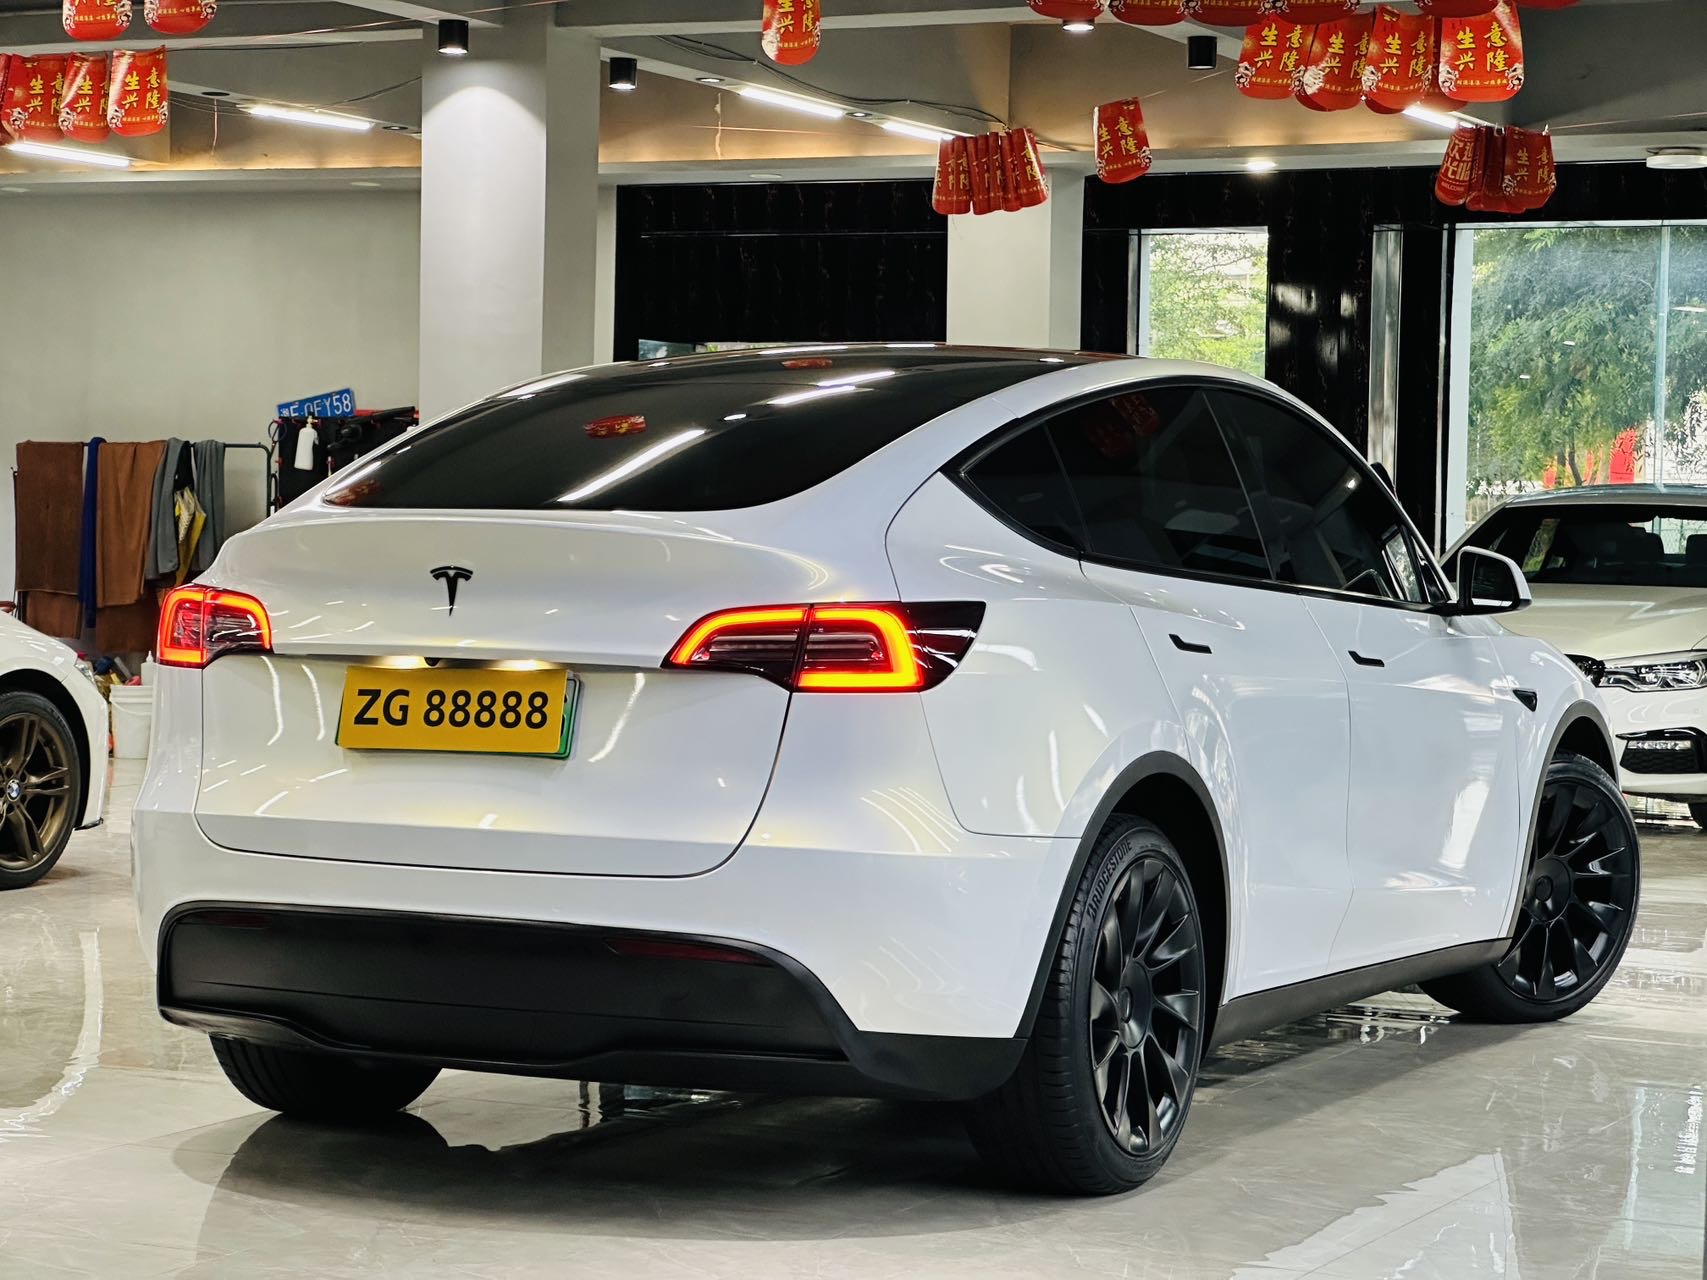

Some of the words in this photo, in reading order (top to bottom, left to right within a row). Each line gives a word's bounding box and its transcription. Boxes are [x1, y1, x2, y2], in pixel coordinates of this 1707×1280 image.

[1260, 22, 1303, 47] 生意
[1327, 30, 1369, 56] 生意
[1384, 31, 1427, 56] 生意
[1456, 22, 1507, 49] 生意
[1254, 48, 1299, 73] 兴隆
[1379, 55, 1427, 78] 兴隆
[1455, 48, 1509, 72] 兴隆
[124, 67, 161, 90] 生意
[121, 90, 161, 110] 兴隆
[1099, 116, 1134, 142] 生意
[1101, 136, 1139, 159] 兴隆
[354, 689, 410, 726] ZG
[423, 689, 549, 730] 88888
[1086, 839, 1133, 923] BRIDGESTONE
